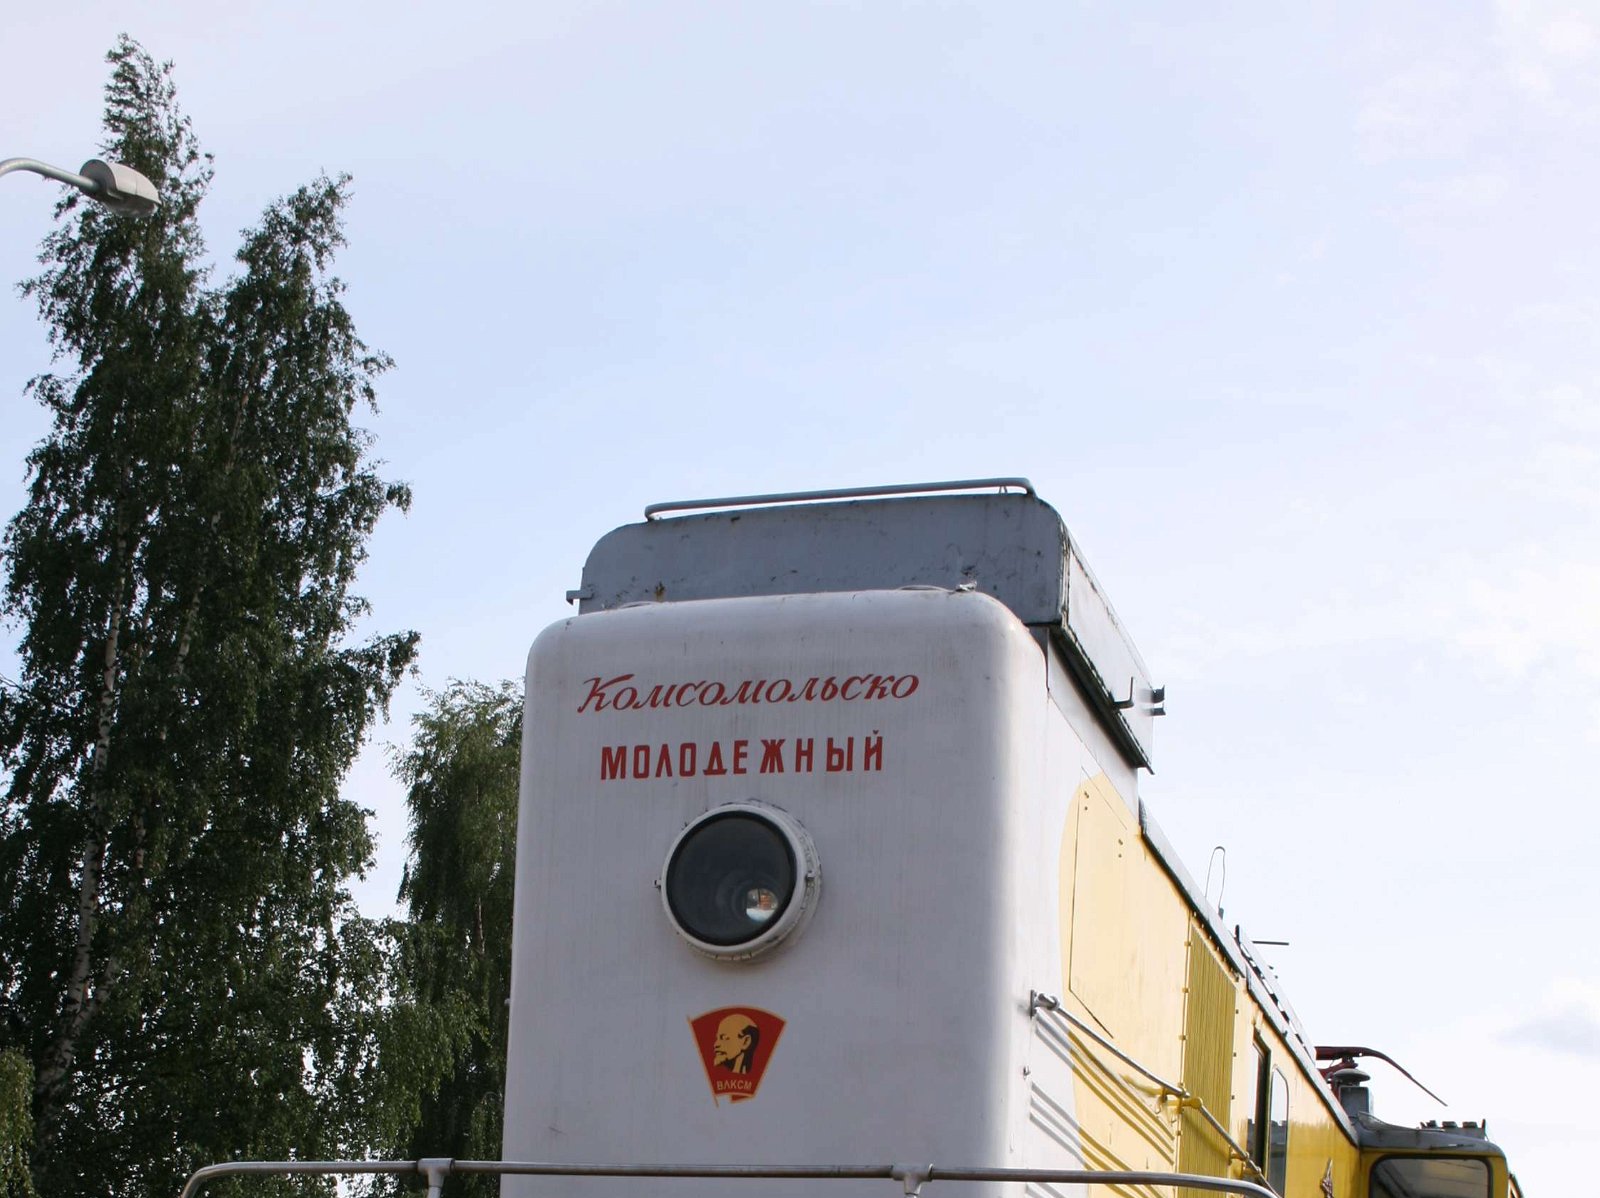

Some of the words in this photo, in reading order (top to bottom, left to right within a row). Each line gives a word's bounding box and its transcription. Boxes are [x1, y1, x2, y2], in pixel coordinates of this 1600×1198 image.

[577, 674, 920, 713] Комсомольско
[600, 730, 883, 780] МОЛОДЕЖНЫЙ
[716, 1079, 753, 1091] ВЛКСМ
